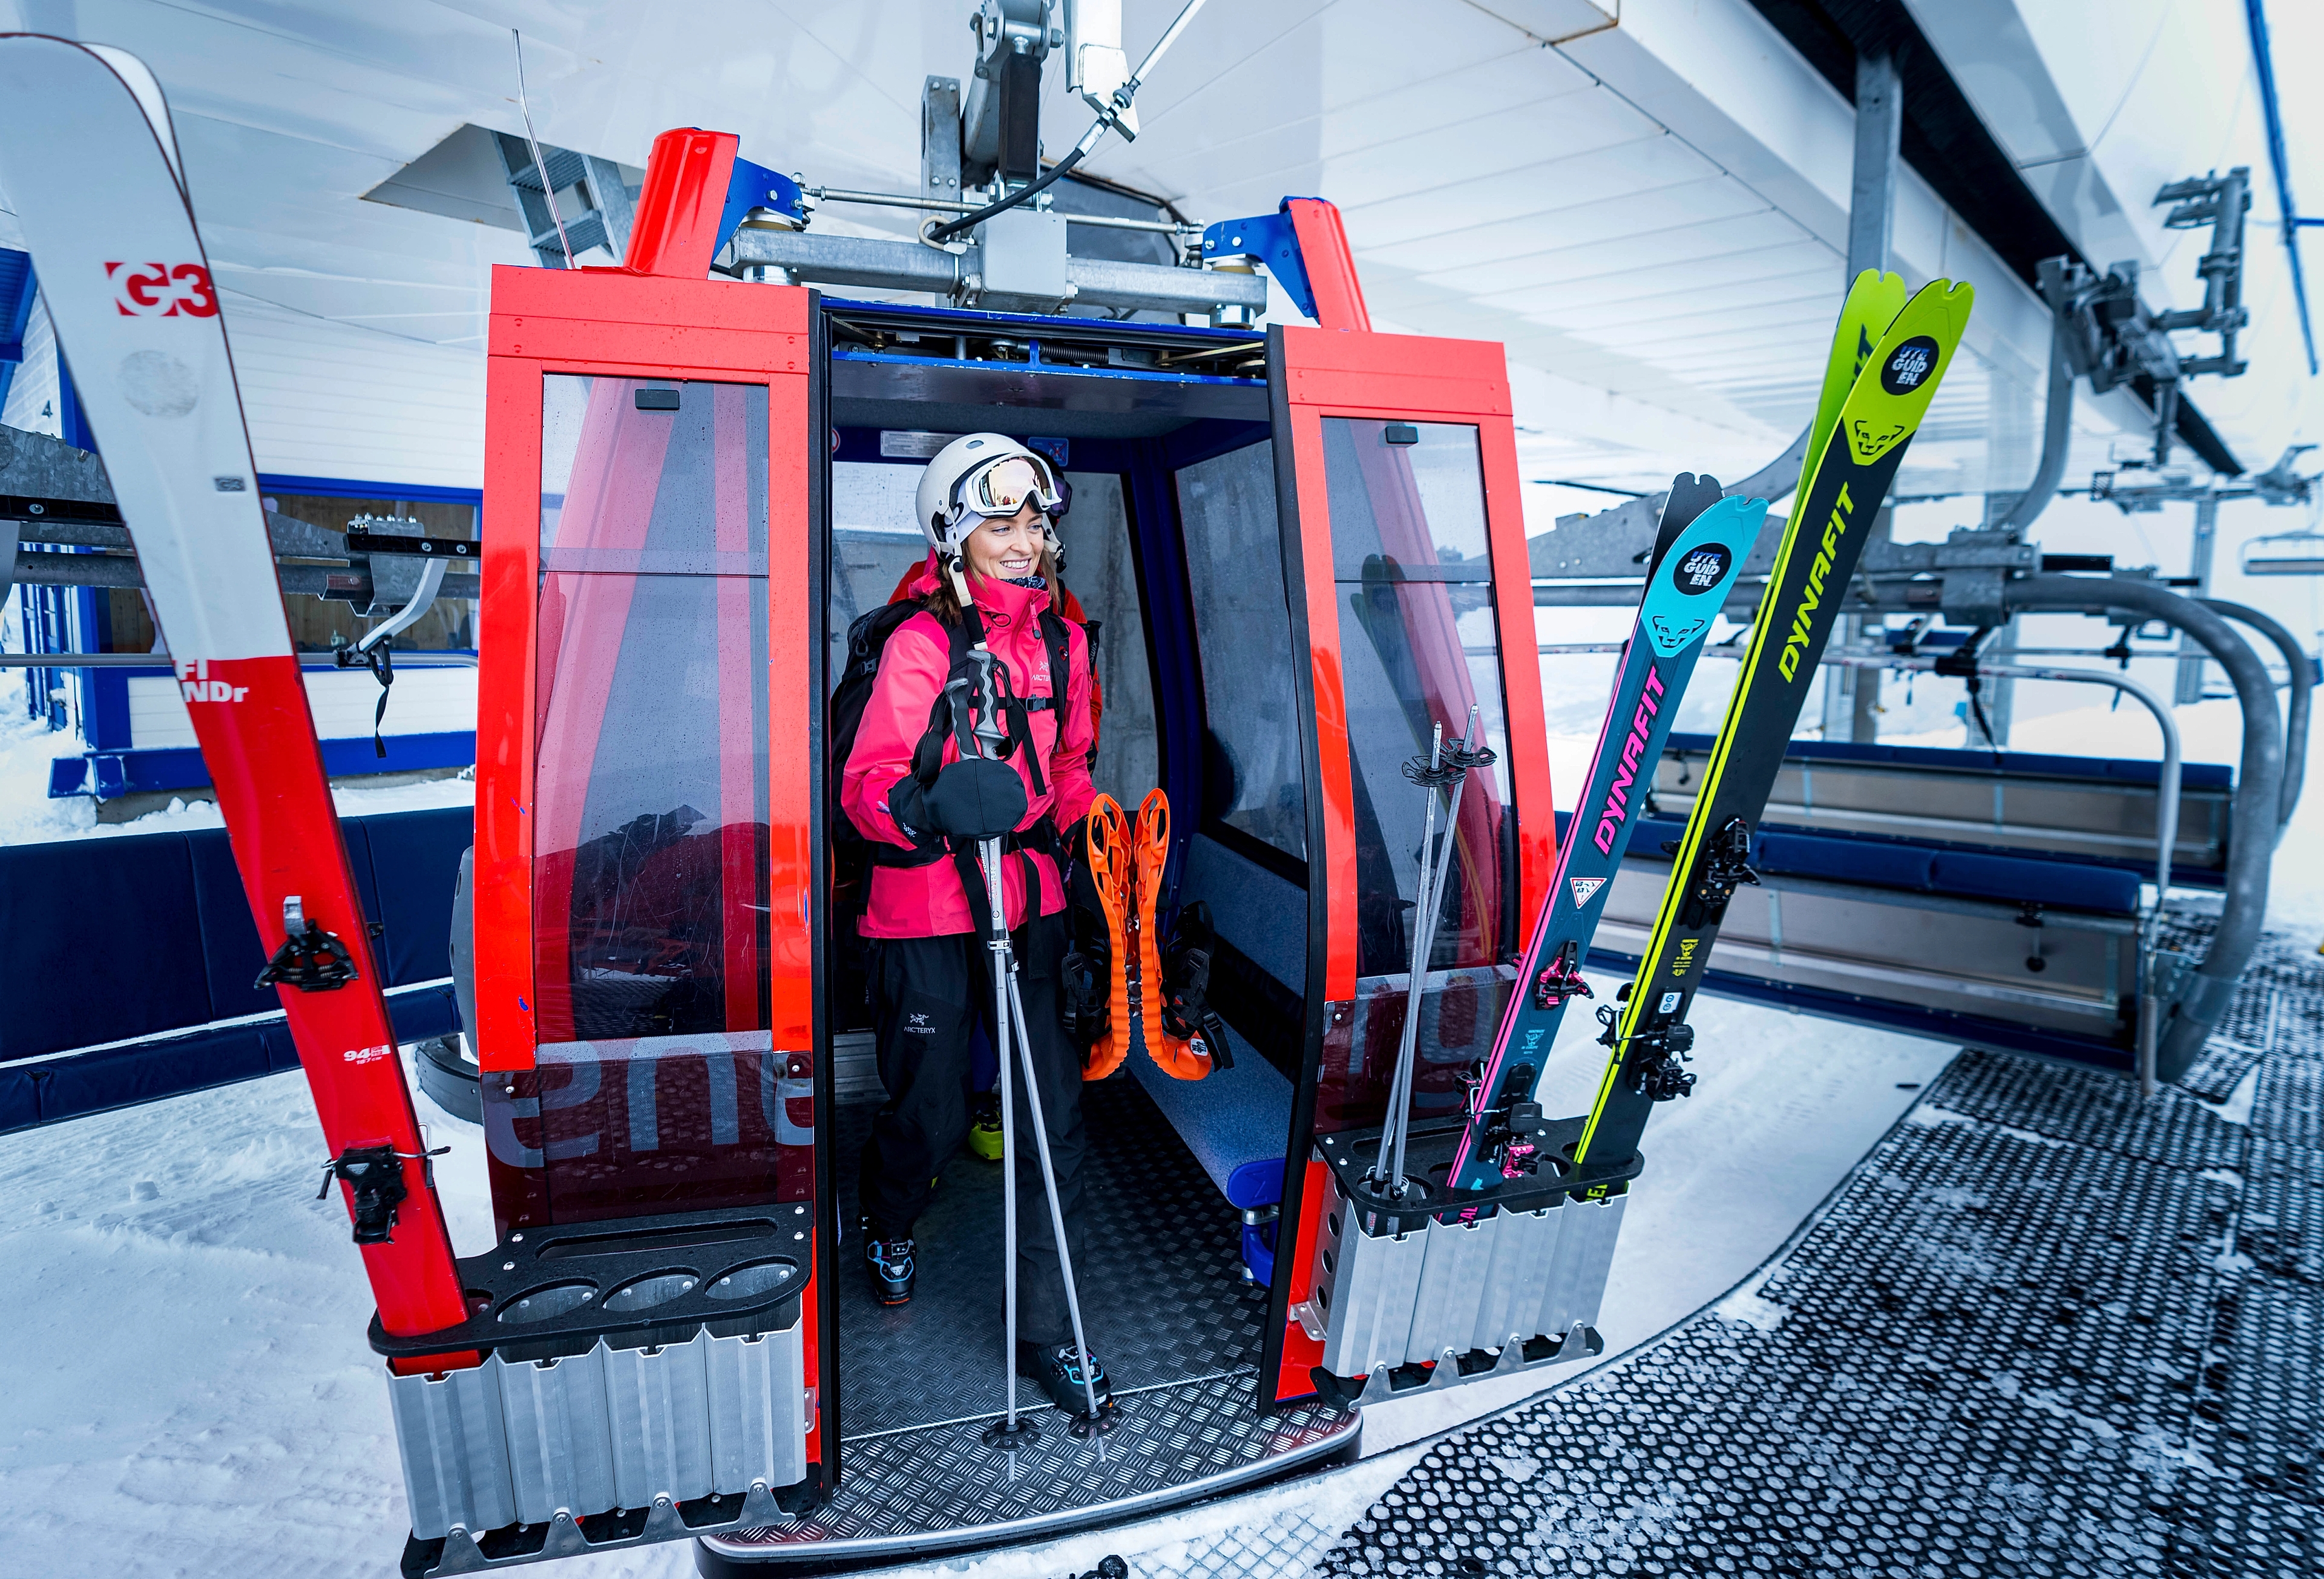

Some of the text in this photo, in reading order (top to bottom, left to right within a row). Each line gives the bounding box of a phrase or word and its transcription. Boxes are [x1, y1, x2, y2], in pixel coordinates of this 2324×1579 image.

[103, 261, 221, 318] G3
[1899, 346, 1930, 361] UTE
[1891, 358, 1928, 373] GUID
[940, 457, 971, 493] POC
[1690, 551, 1722, 565] UTE
[1683, 562, 1721, 576] GUID
[1777, 481, 1854, 683] DYNAFIT
[1594, 665, 1664, 855] DYNAFIT
[343, 1048, 371, 1062] 94
